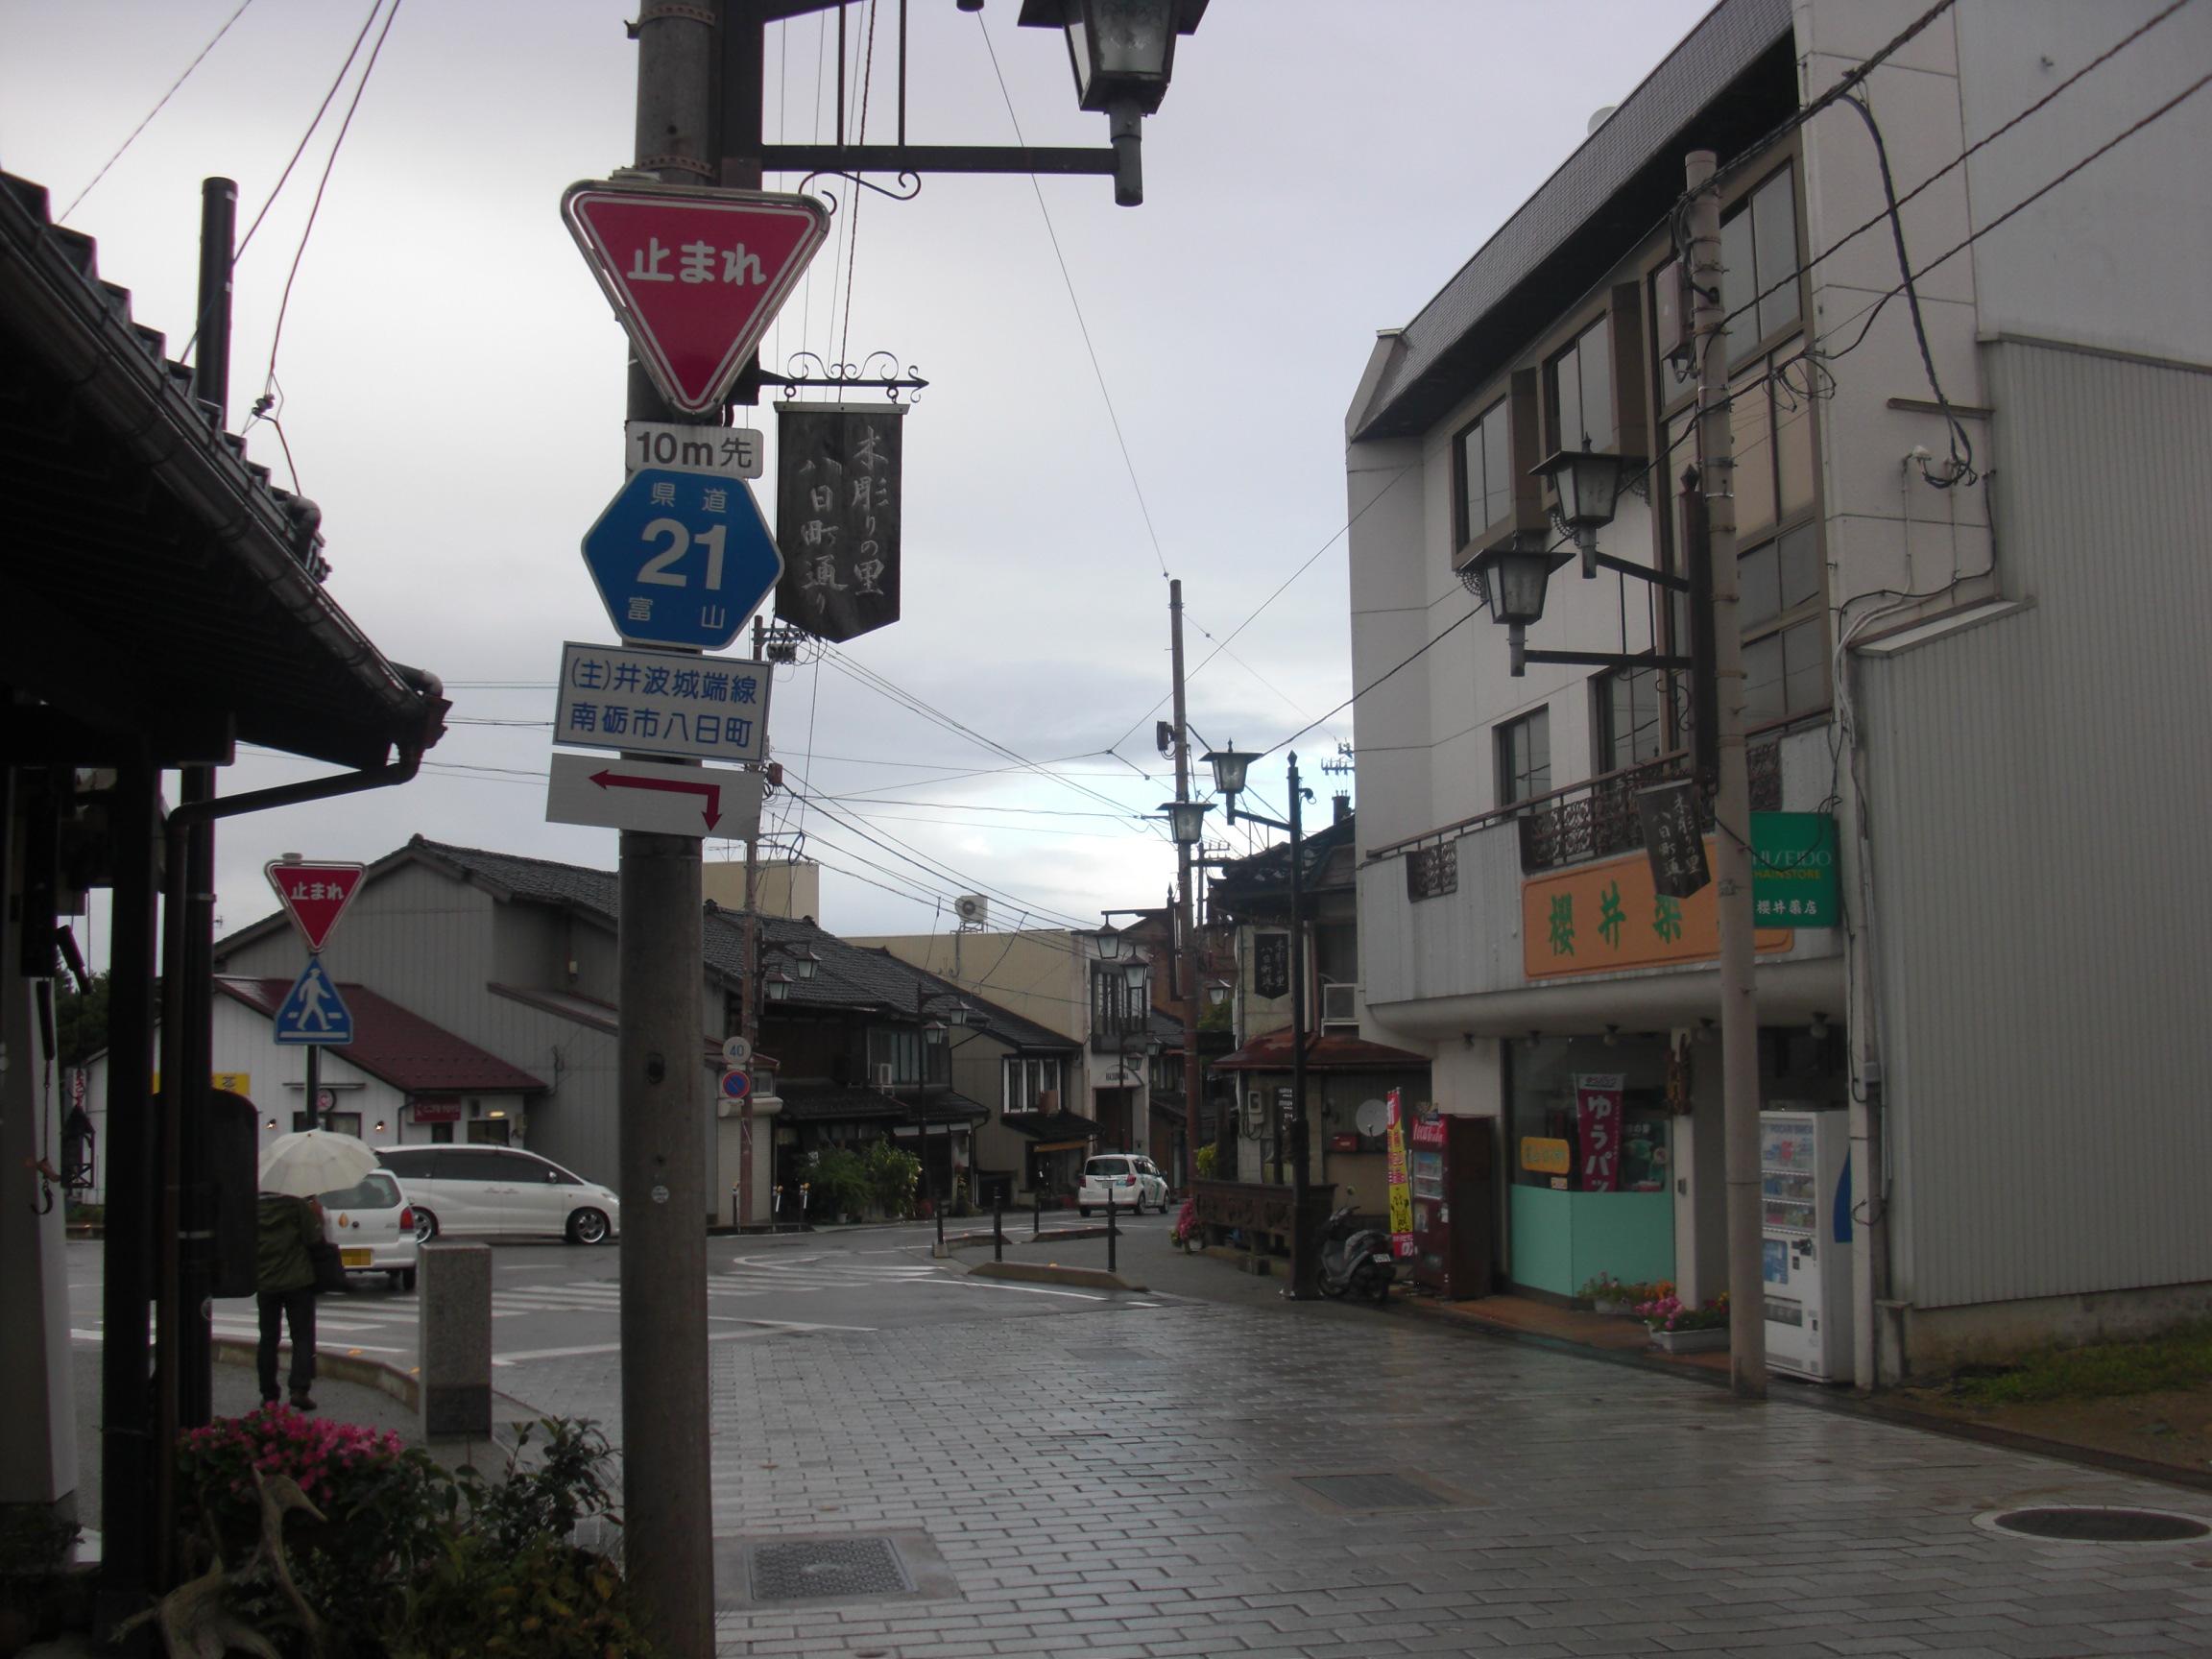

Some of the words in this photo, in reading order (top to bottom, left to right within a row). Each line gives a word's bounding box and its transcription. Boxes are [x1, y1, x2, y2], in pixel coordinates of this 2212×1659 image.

[627, 237, 767, 286] 止まれ
[636, 431, 753, 469] 10m先
[650, 482, 729, 514] 県道
[851, 424, 890, 597] 木彫りの里
[637, 517, 728, 591] 21
[799, 455, 850, 615] 八日町通り
[627, 595, 726, 630] 富山
[571, 658, 758, 706] (主)井波城端線
[570, 701, 754, 749] 南砺市八日町
[1752, 850, 1832, 866] HISEIDO
[290, 880, 345, 901] 止まれ
[729, 1044, 745, 1057] 40
